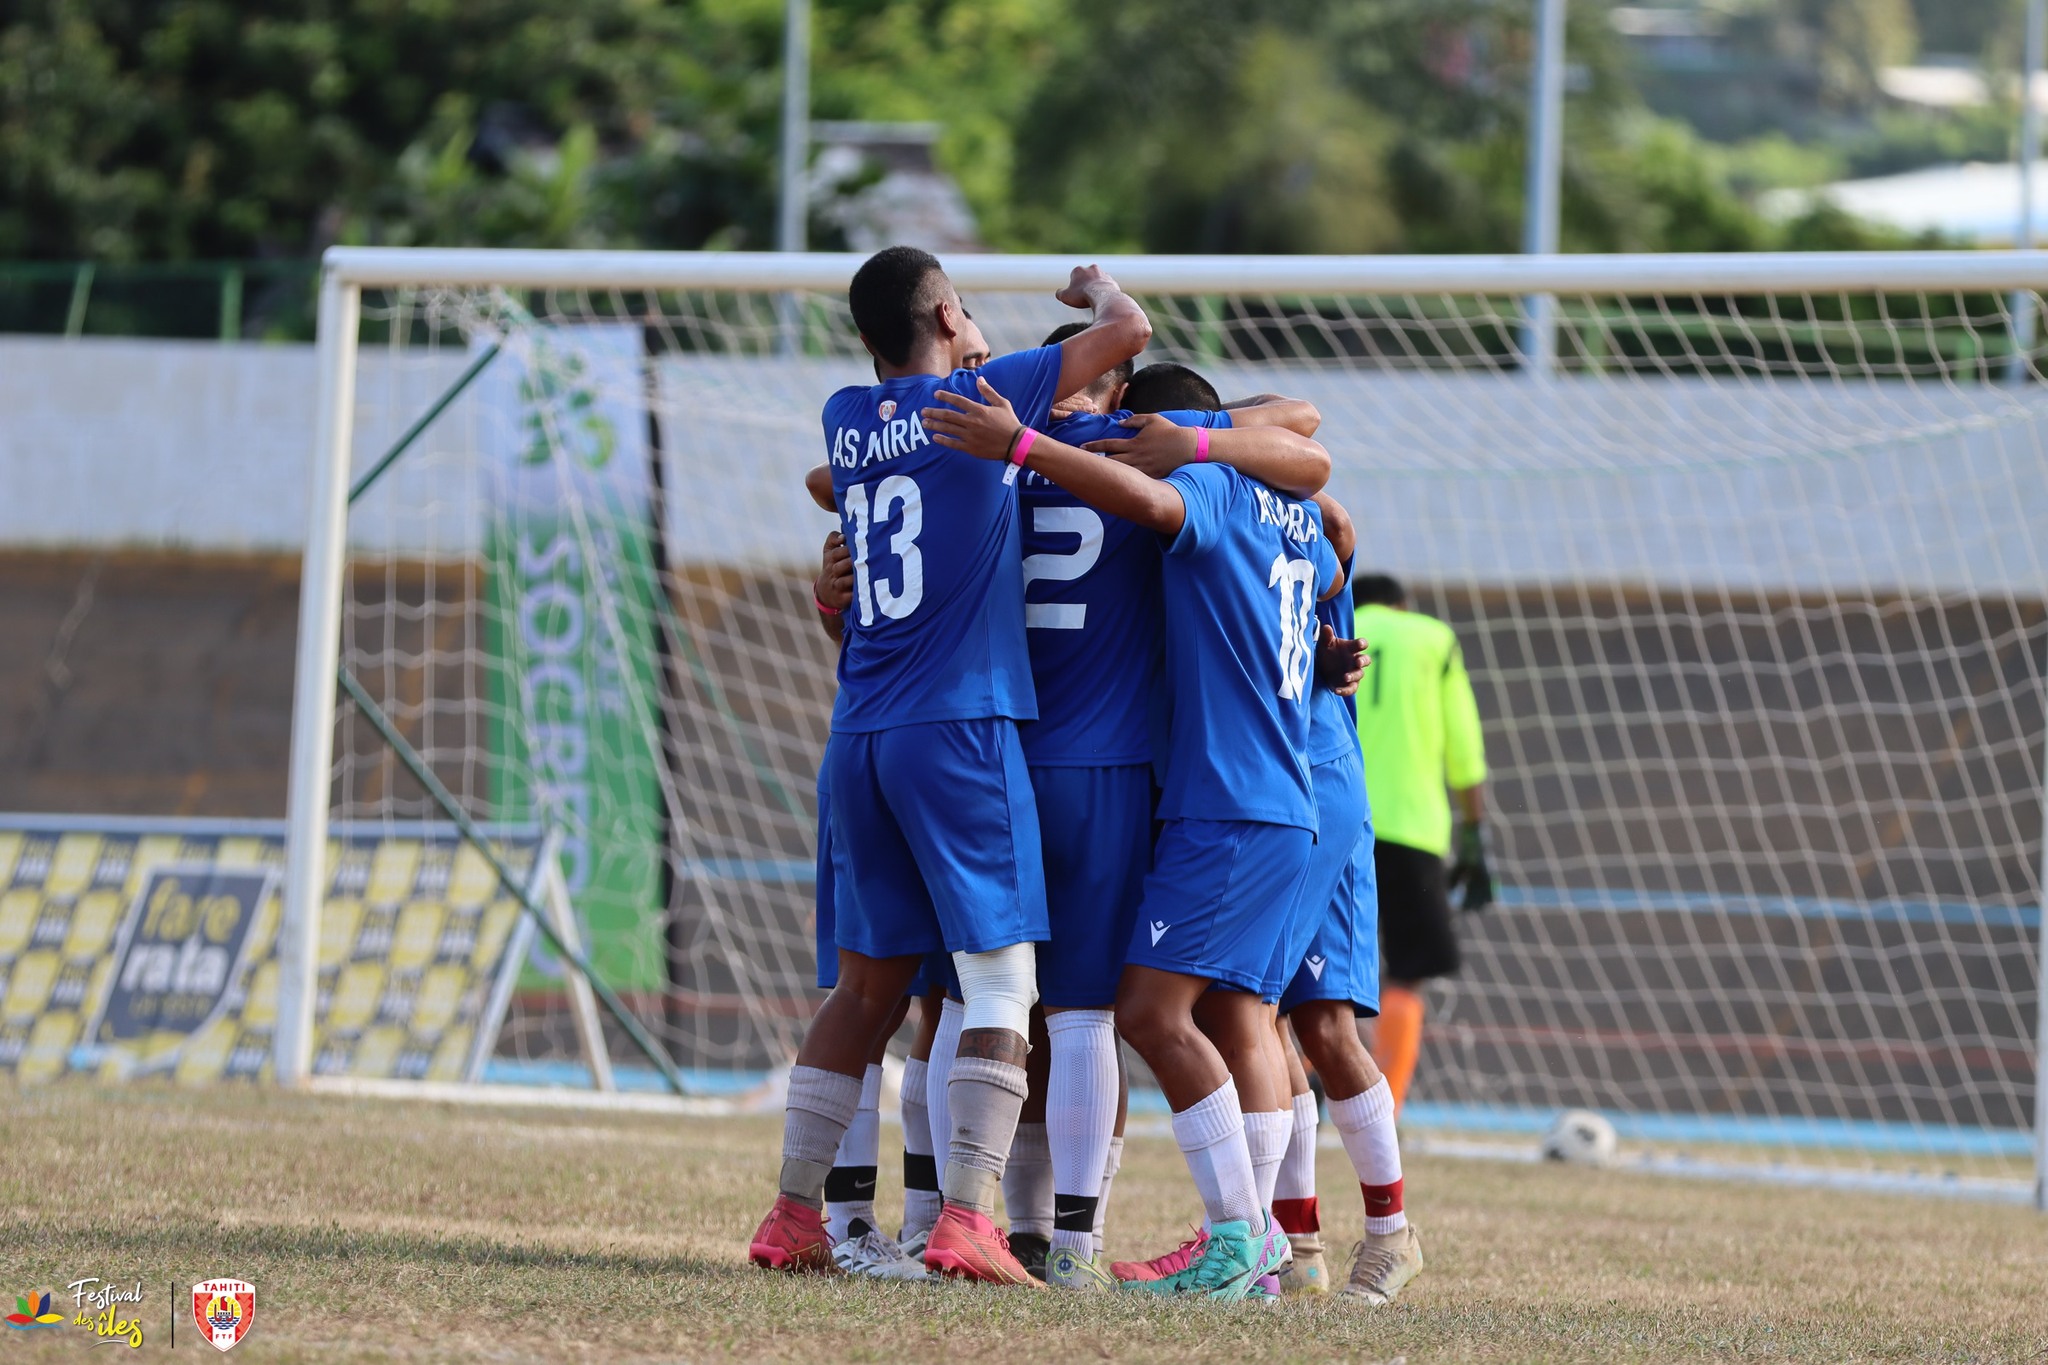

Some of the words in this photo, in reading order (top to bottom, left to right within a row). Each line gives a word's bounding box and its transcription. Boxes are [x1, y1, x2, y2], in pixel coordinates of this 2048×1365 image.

[832, 427, 860, 469] AS
[845, 475, 922, 627] 13
[1021, 506, 1104, 630] 2
[1254, 486, 1280, 526] AS
[1275, 495, 1318, 543] MRA
[1268, 552, 1315, 704] 10
